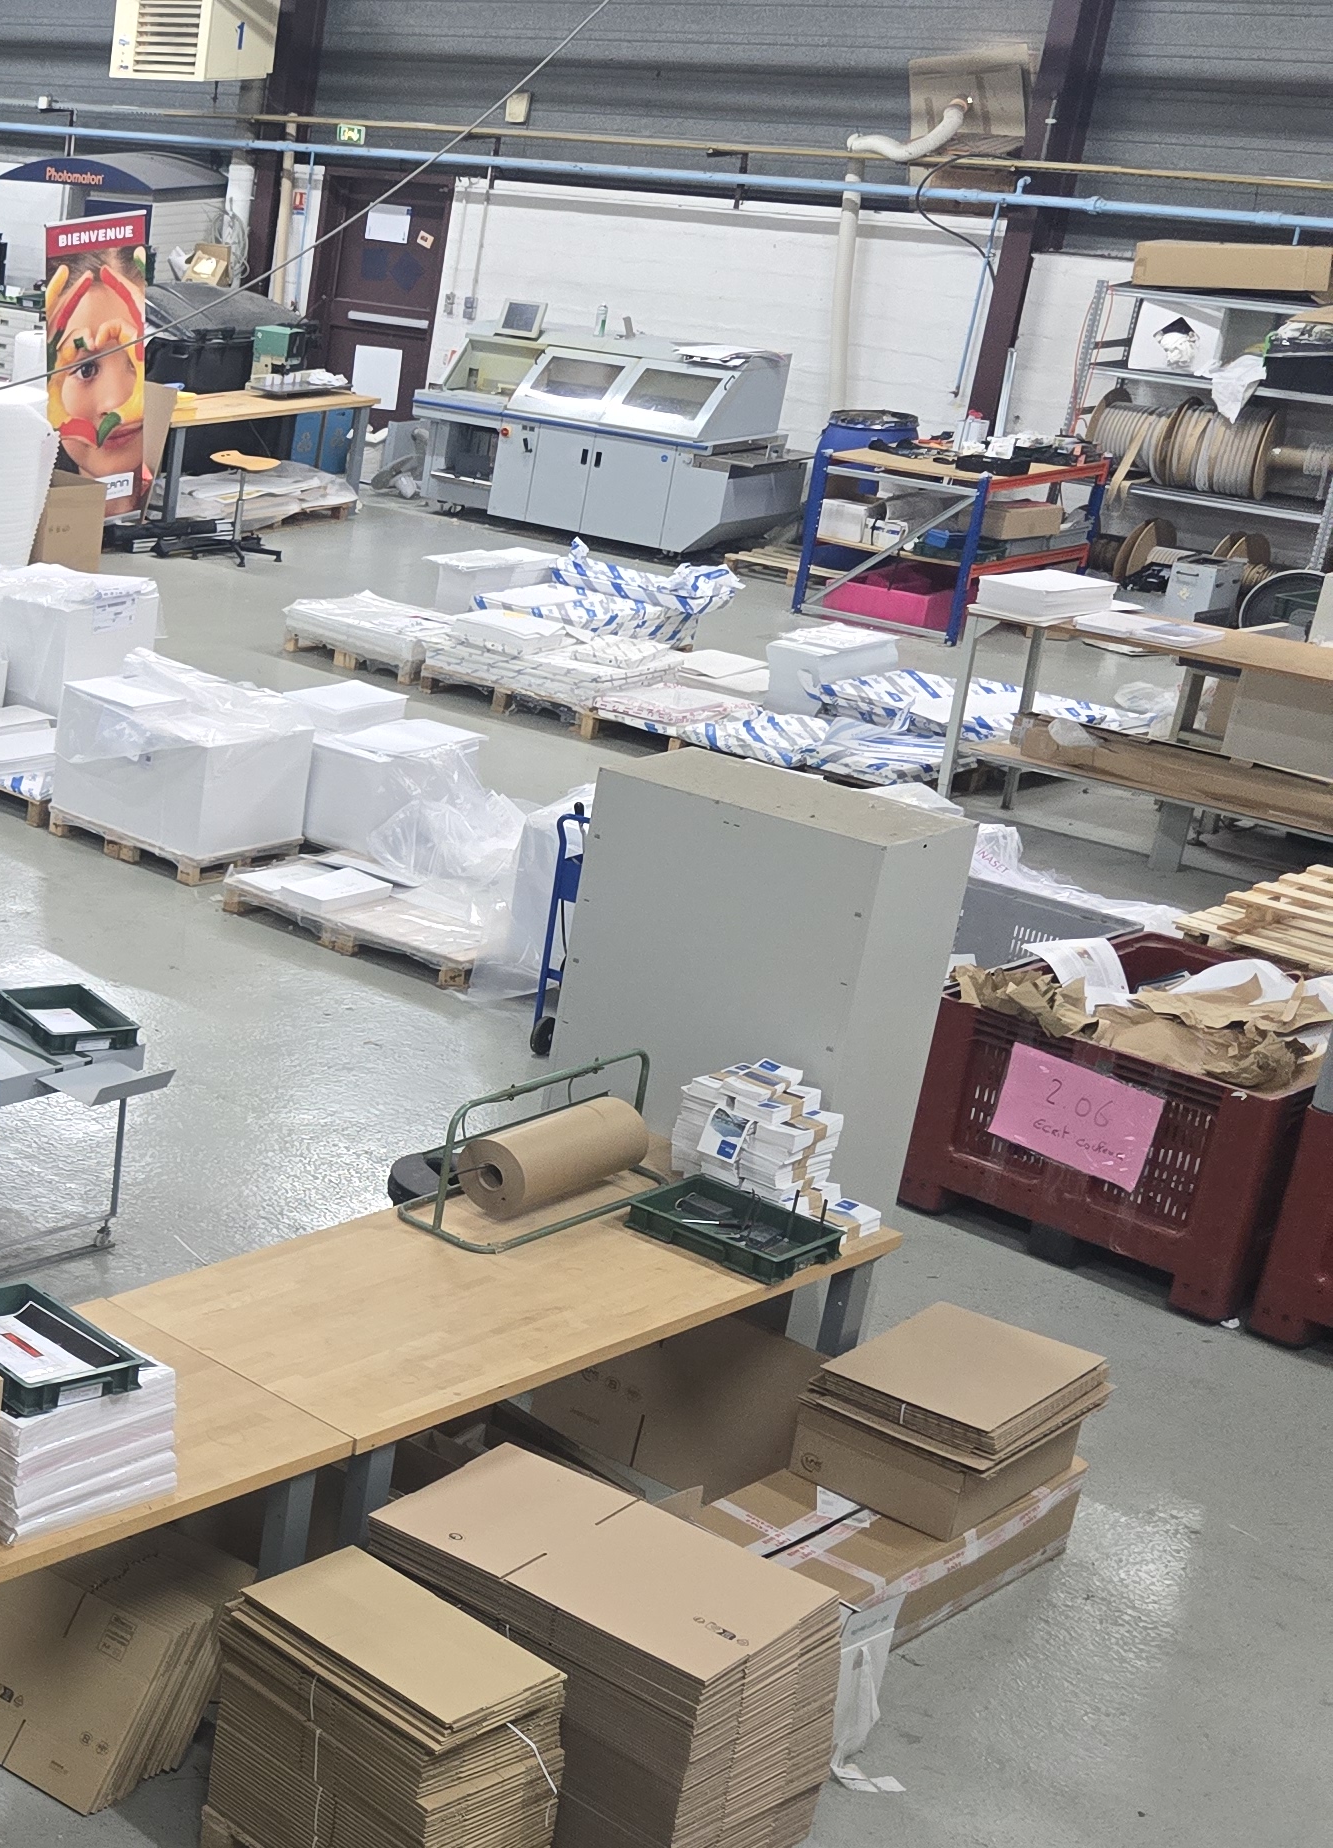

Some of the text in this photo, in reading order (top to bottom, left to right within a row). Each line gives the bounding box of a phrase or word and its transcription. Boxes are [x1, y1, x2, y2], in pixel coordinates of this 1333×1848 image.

[236, 21, 245, 50] 1
[45, 166, 103, 185] Photomaton
[58, 225, 134, 247] BIENVENUE
